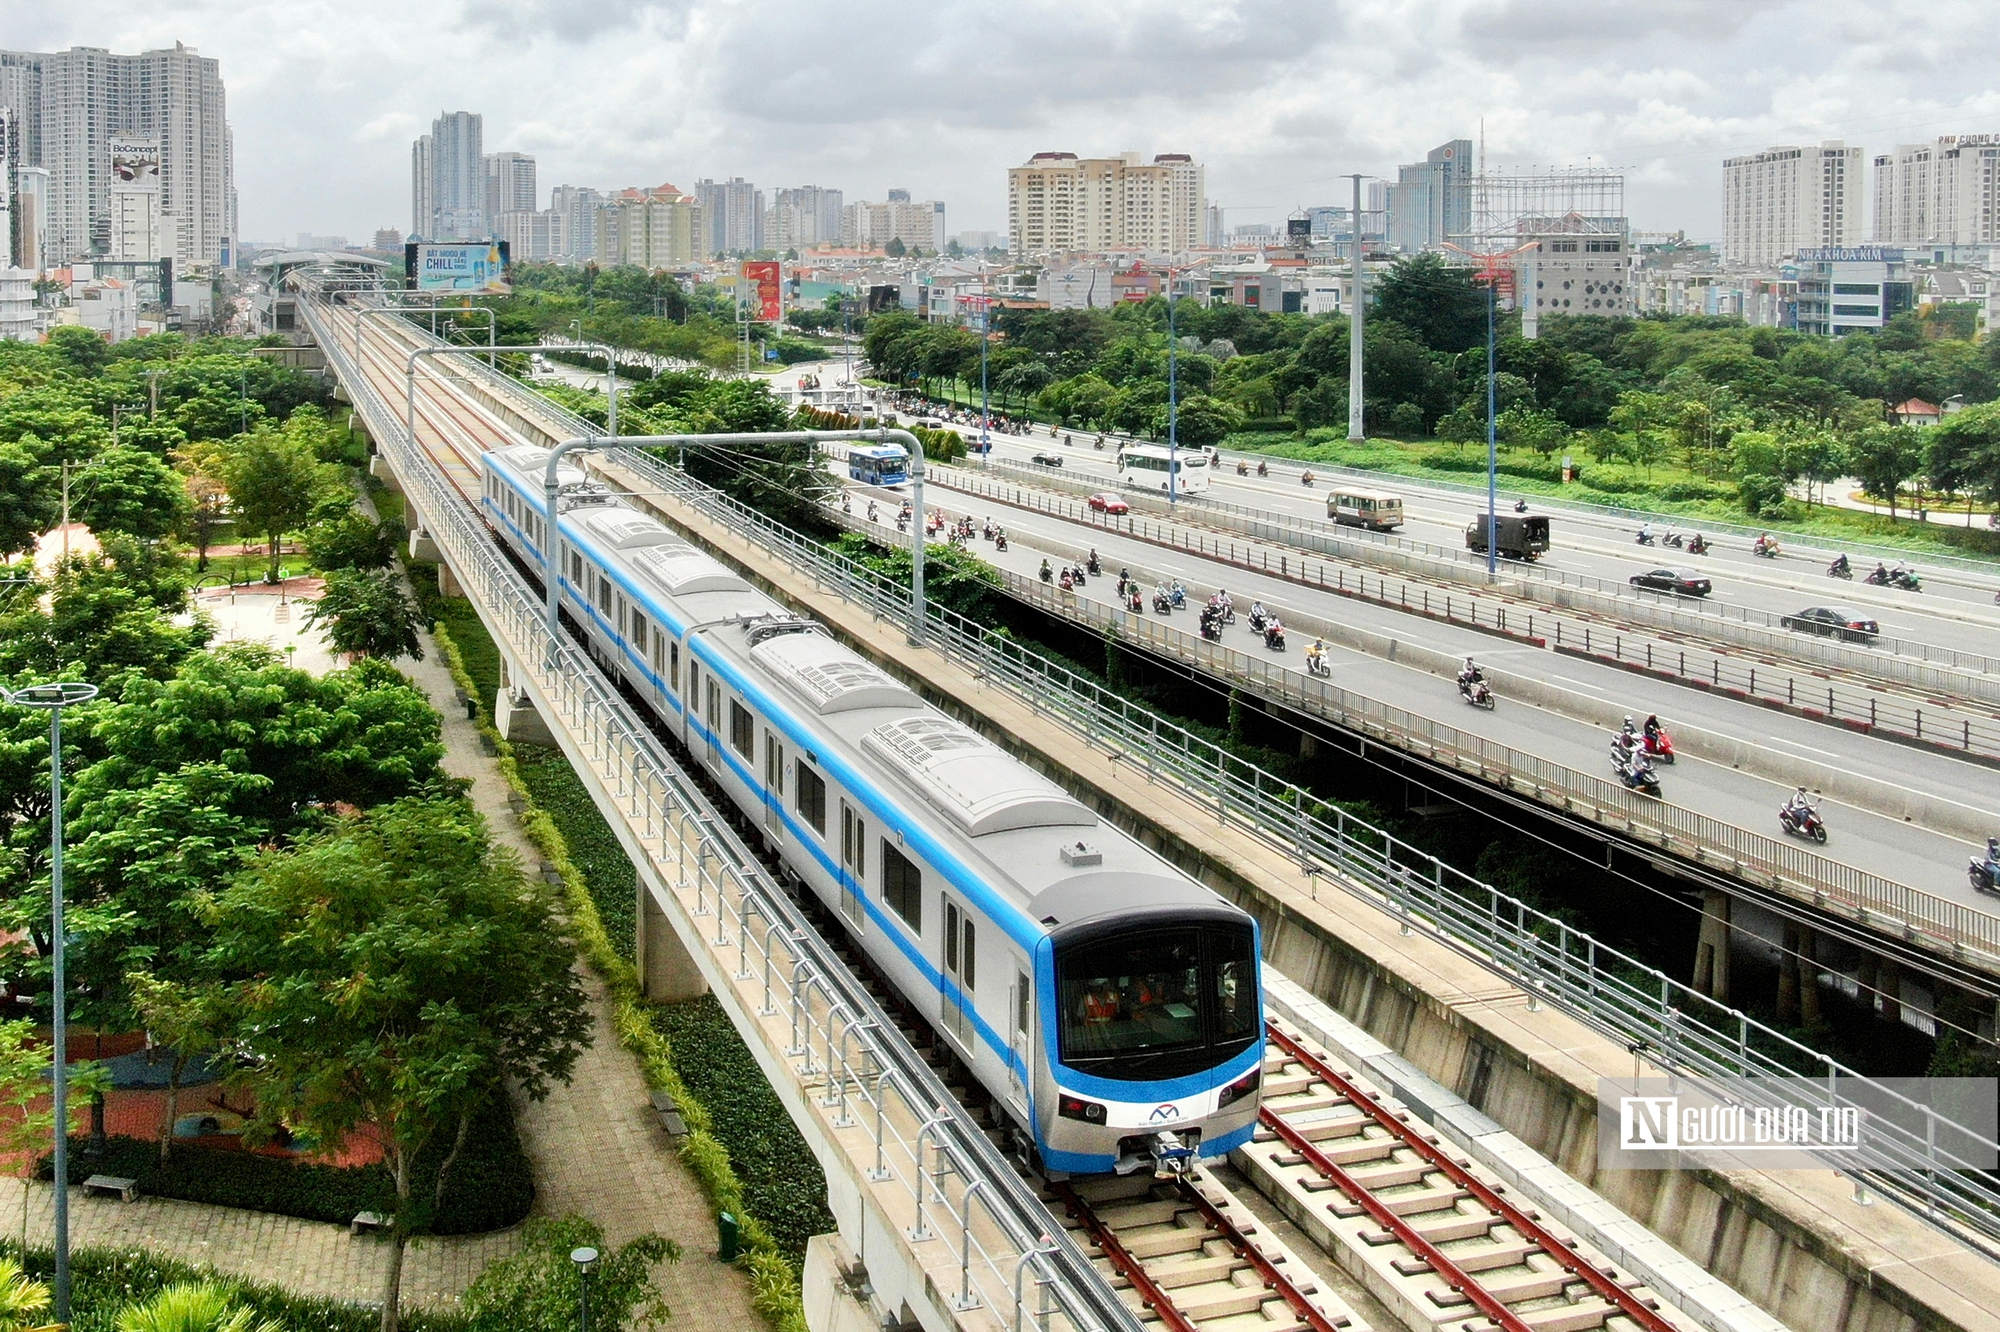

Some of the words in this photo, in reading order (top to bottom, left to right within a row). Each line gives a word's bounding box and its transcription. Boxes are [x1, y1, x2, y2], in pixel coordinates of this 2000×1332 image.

[113, 145, 158, 154] BoConcept
[1799, 249, 1821, 260] NHA
[1824, 249, 1857, 260] KHOA
[1860, 249, 1881, 260] KIM
[426, 258, 453, 270] CHILL
[1307, 257, 1334, 265] HOTEL
